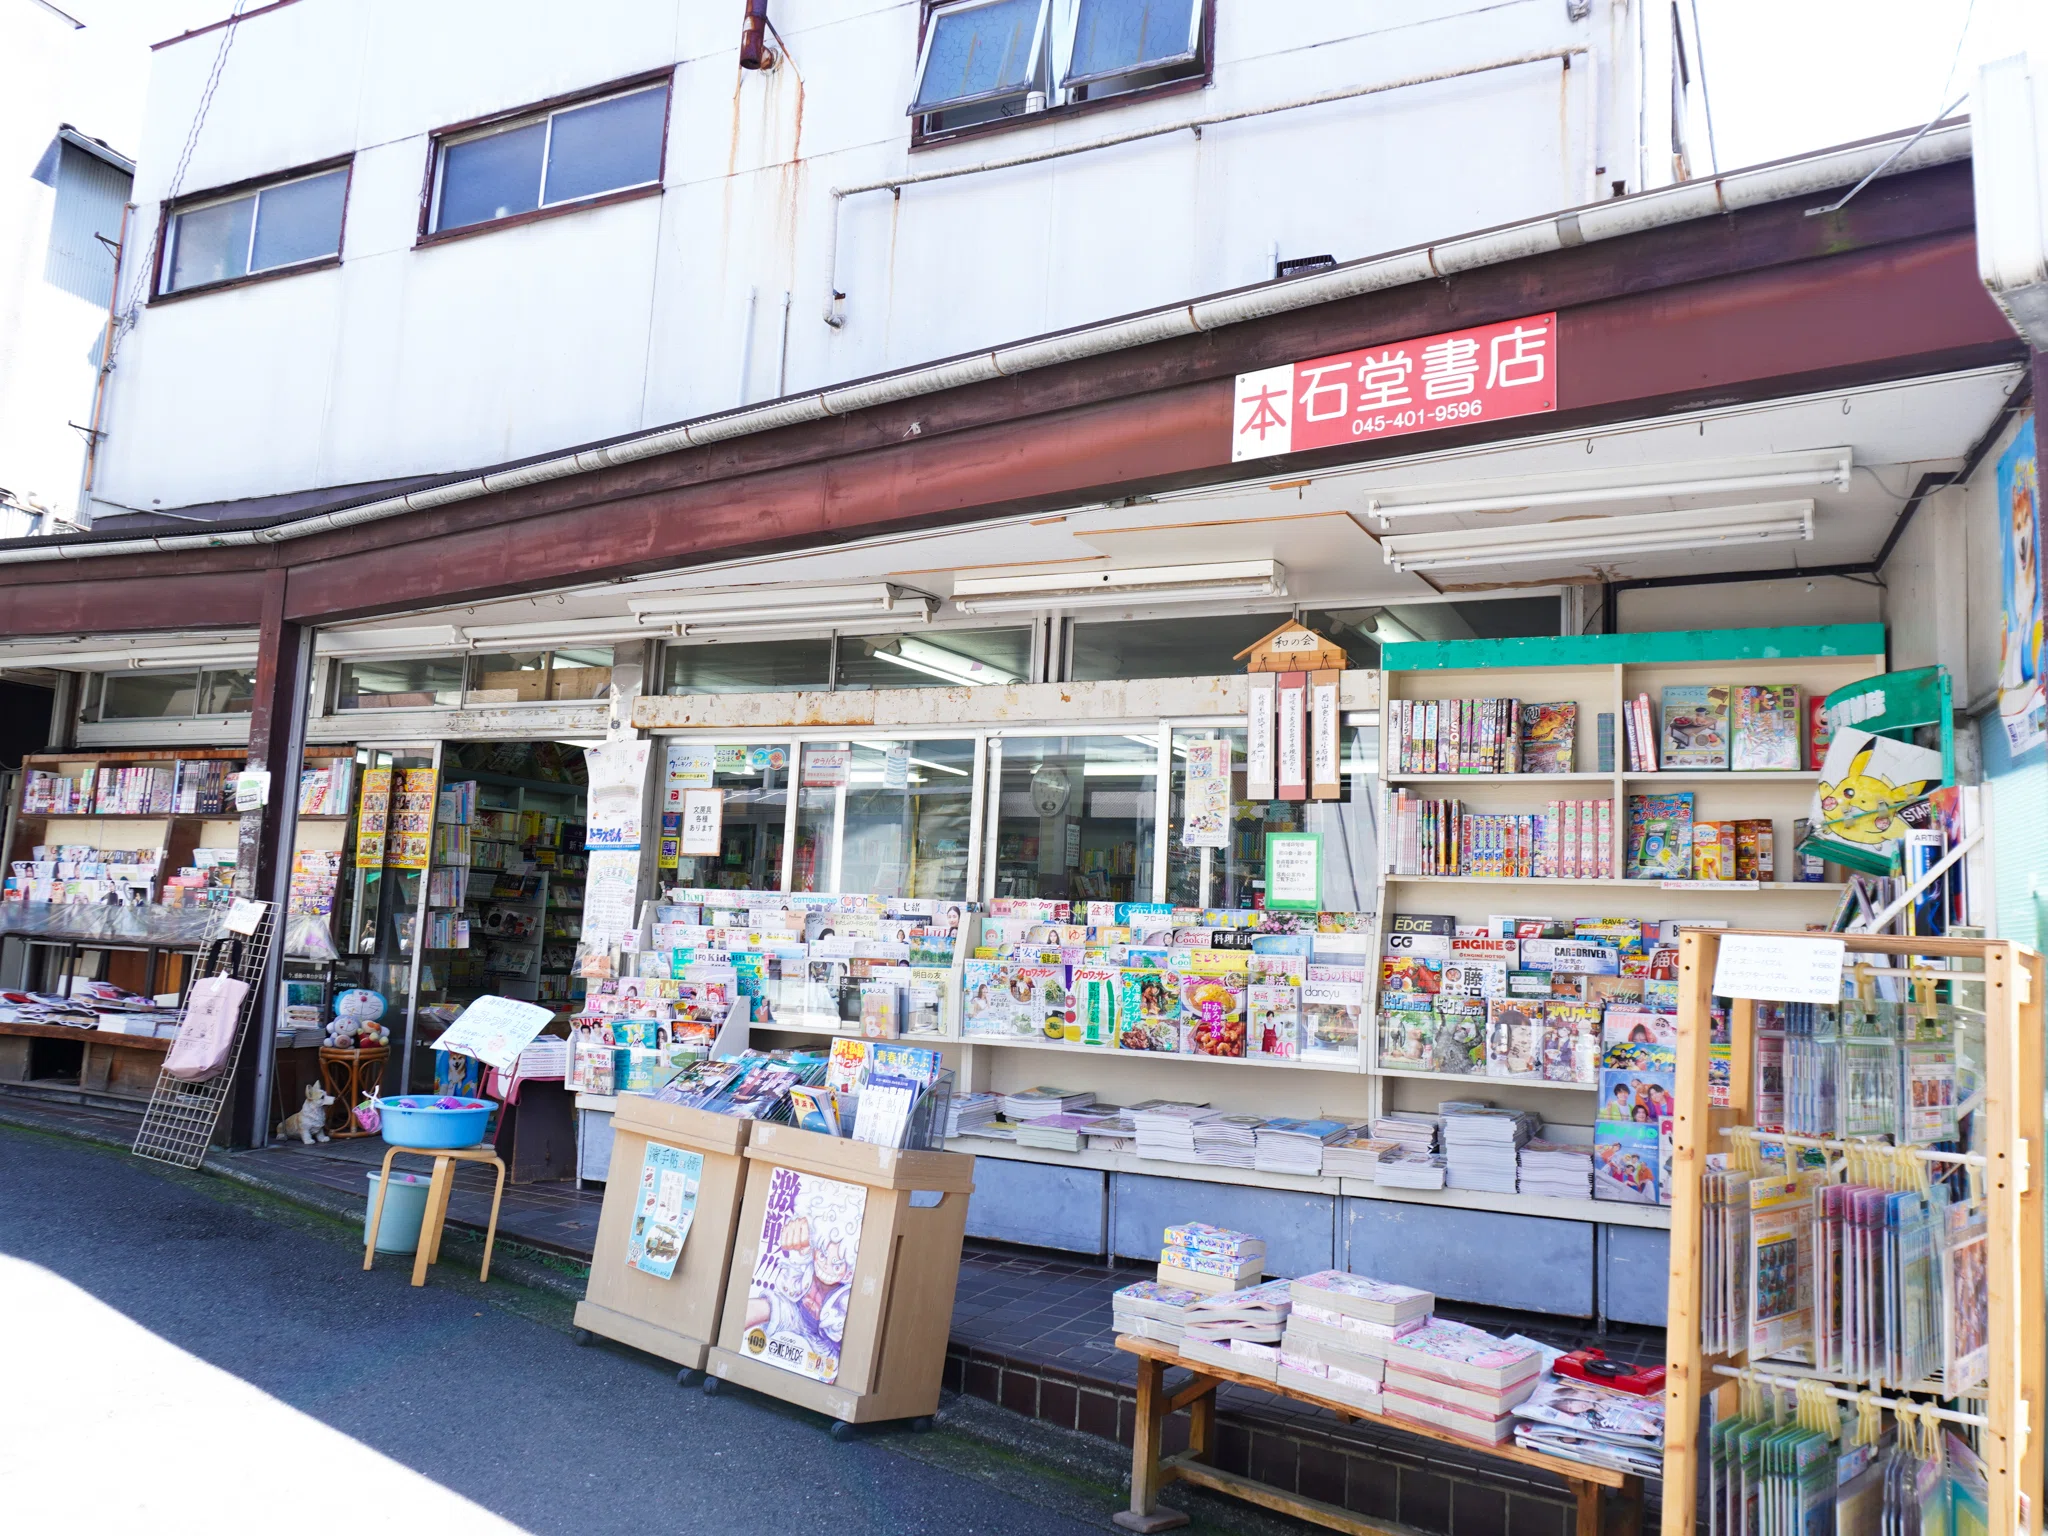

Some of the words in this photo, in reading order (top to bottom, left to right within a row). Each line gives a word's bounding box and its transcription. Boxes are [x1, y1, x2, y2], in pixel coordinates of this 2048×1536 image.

[1299, 325, 1548, 423] 石堂書店
[1240, 384, 1287, 441] 本
[1351, 399, 1483, 436] 045-401-9596
[1274, 634, 1315, 649] 和の会
[812, 756, 844, 765] ゆうパック
[693, 805, 712, 814] 文房具
[1643, 801, 1681, 810] ICカード
[696, 815, 708, 823] 各種
[1641, 809, 1690, 819] かいさつき
[689, 824, 714, 832] あります
[589, 827, 622, 843] ドラえもん
[903, 902, 920, 913] 七緒
[1090, 903, 1115, 916] 盆栽
[1394, 920, 1433, 932] EDGE
[1601, 918, 1622, 926] RAV4
[1390, 936, 1413, 948] CG
[1452, 939, 1504, 951] ENGINE
[708, 953, 732, 962] Kids
[1554, 947, 1572, 957] CAR
[1576, 947, 1607, 959] DRIVER
[912, 971, 942, 980] 明日の友
[1017, 967, 1057, 978] クロワッサン
[1074, 969, 1115, 981] クロワッサン
[1304, 984, 1340, 1000] dancyu
[1601, 981, 1639, 1000] Tokyo
[1202, 1002, 1212, 1022] 中華
[1211, 1003, 1221, 1039] かろやか
[1275, 1042, 1295, 1058] 40
[877, 1049, 930, 1067] 青春18きっぷ
